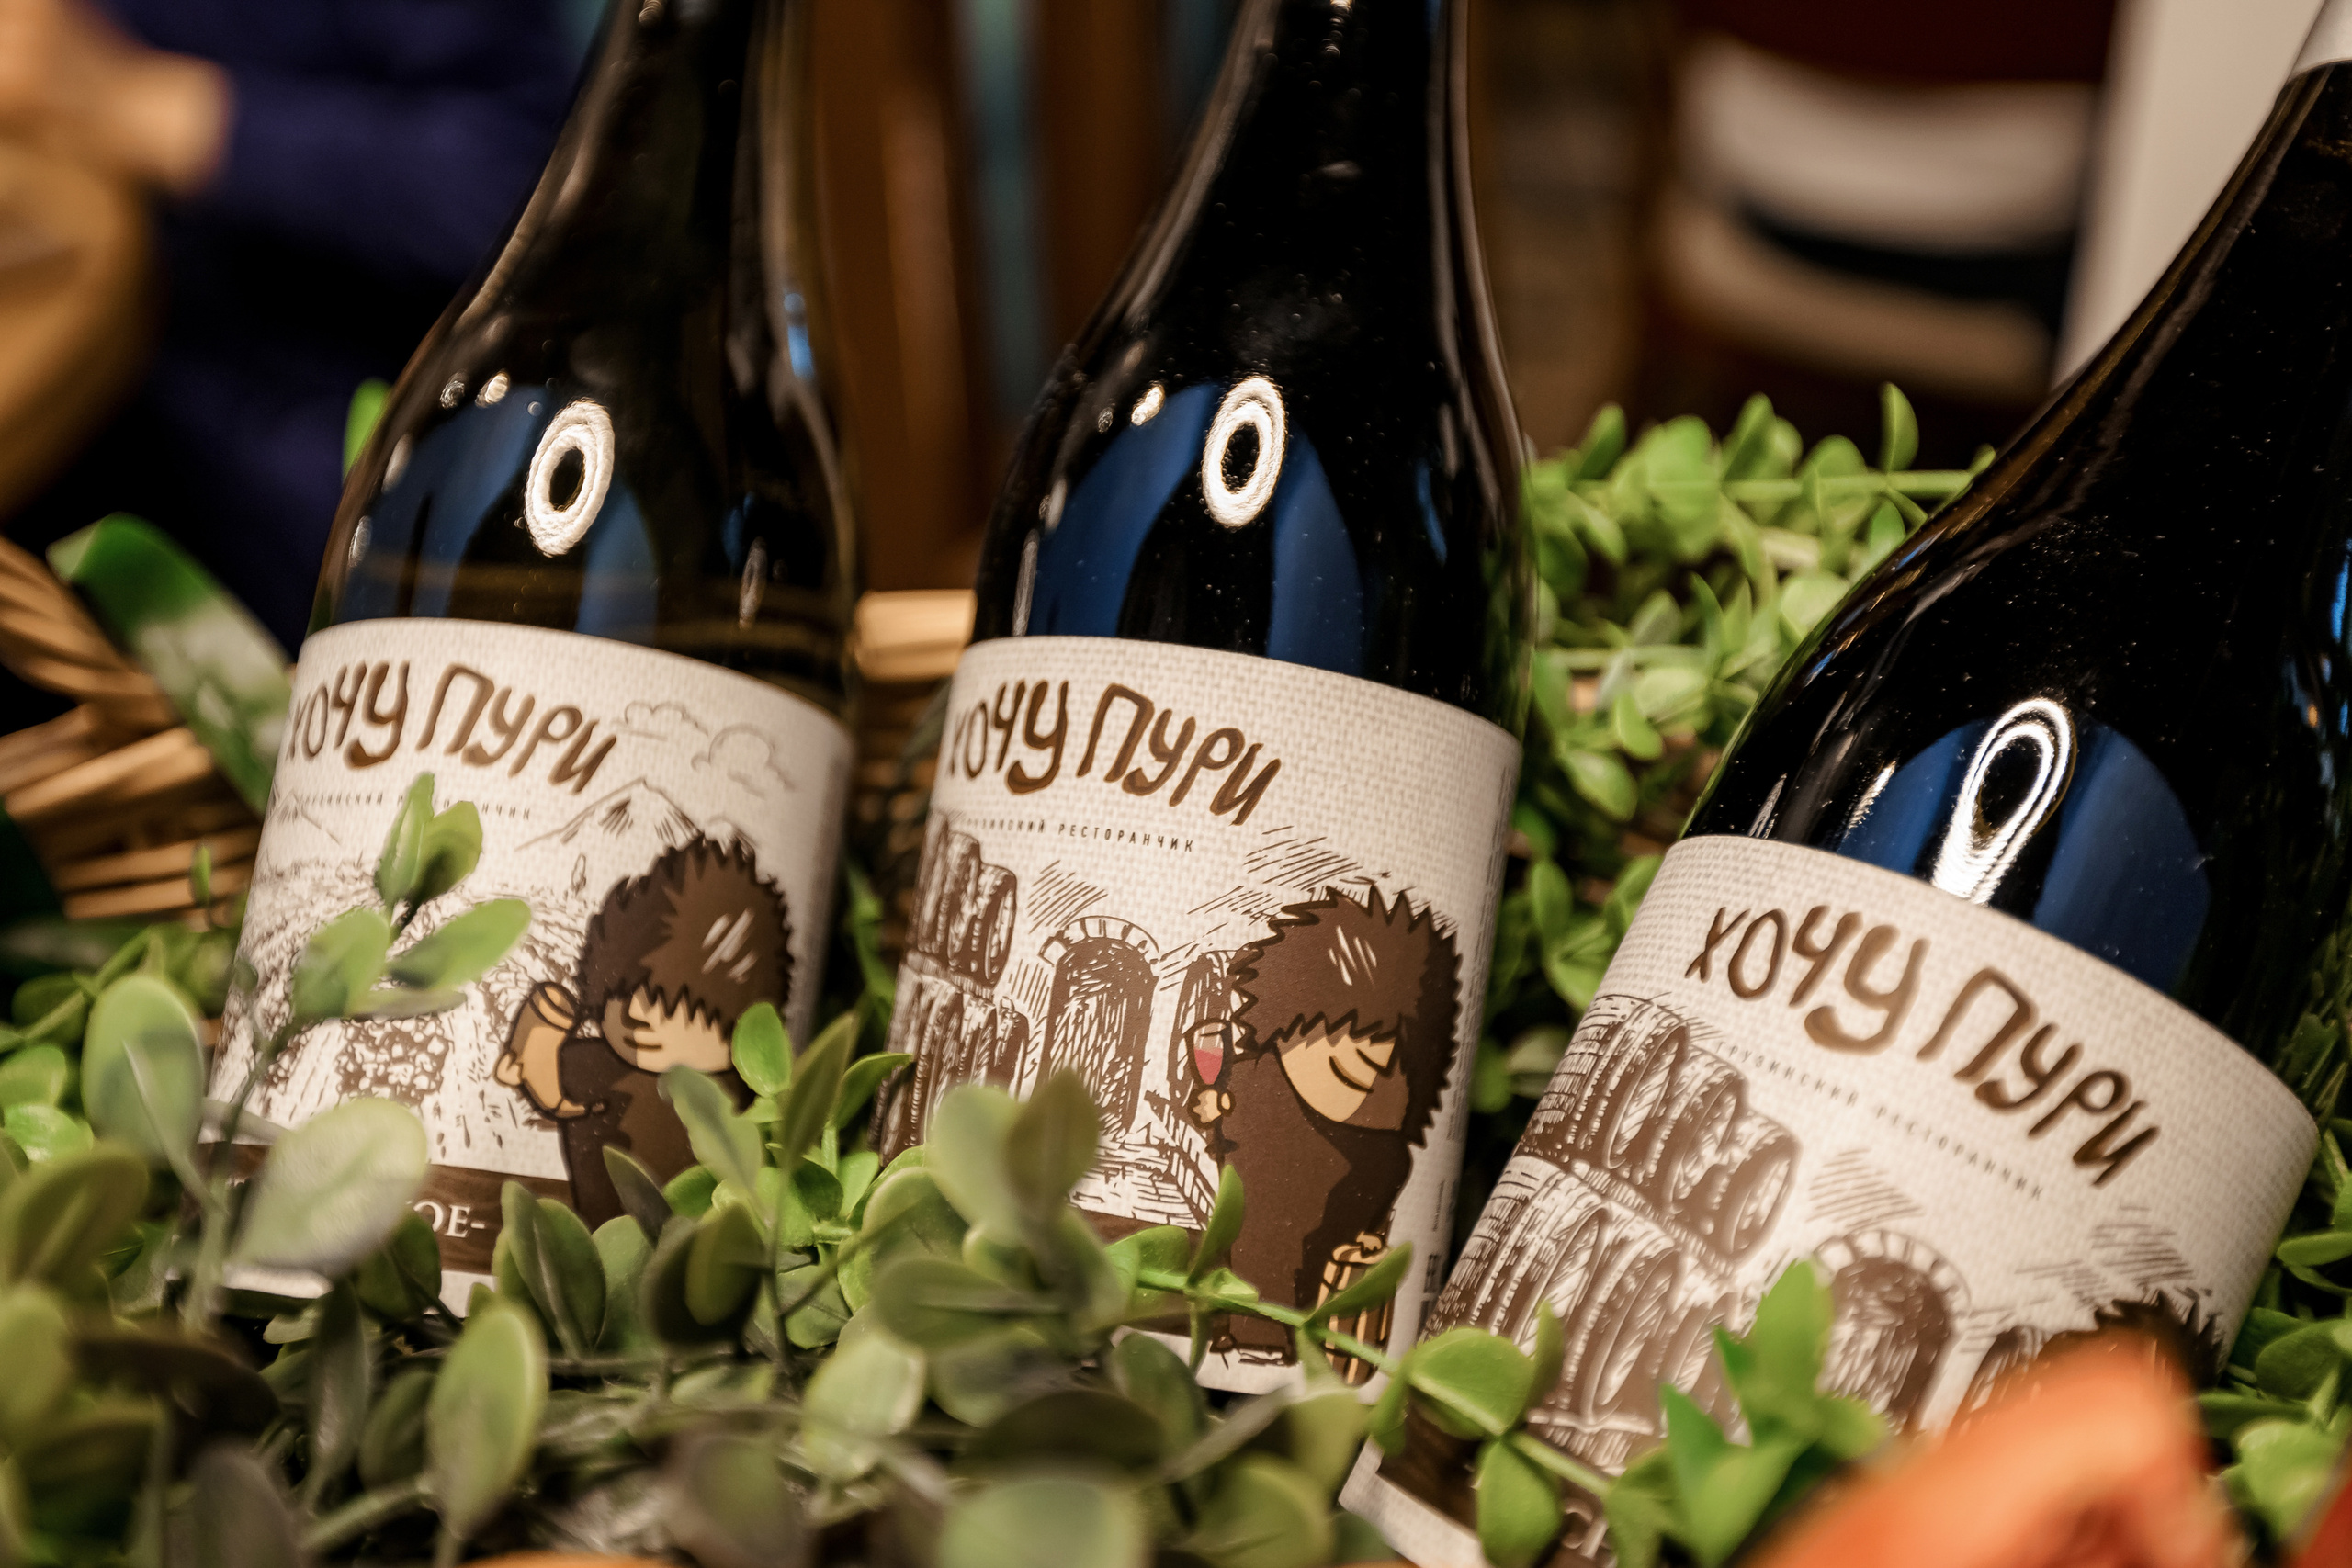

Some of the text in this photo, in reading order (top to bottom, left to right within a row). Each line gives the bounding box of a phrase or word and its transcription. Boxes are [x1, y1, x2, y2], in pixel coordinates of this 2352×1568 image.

[285, 659, 617, 795] ХОЧУ ПУРИ
[945, 678, 1282, 826] ХОЧУ ПУРИ
[960, 818, 1193, 852] РУЗИНСКИЙ РЕСТОРАНЧИК
[1684, 905, 1931, 1055] ХОЧУ
[1916, 966, 2162, 1189] ПУРИ
